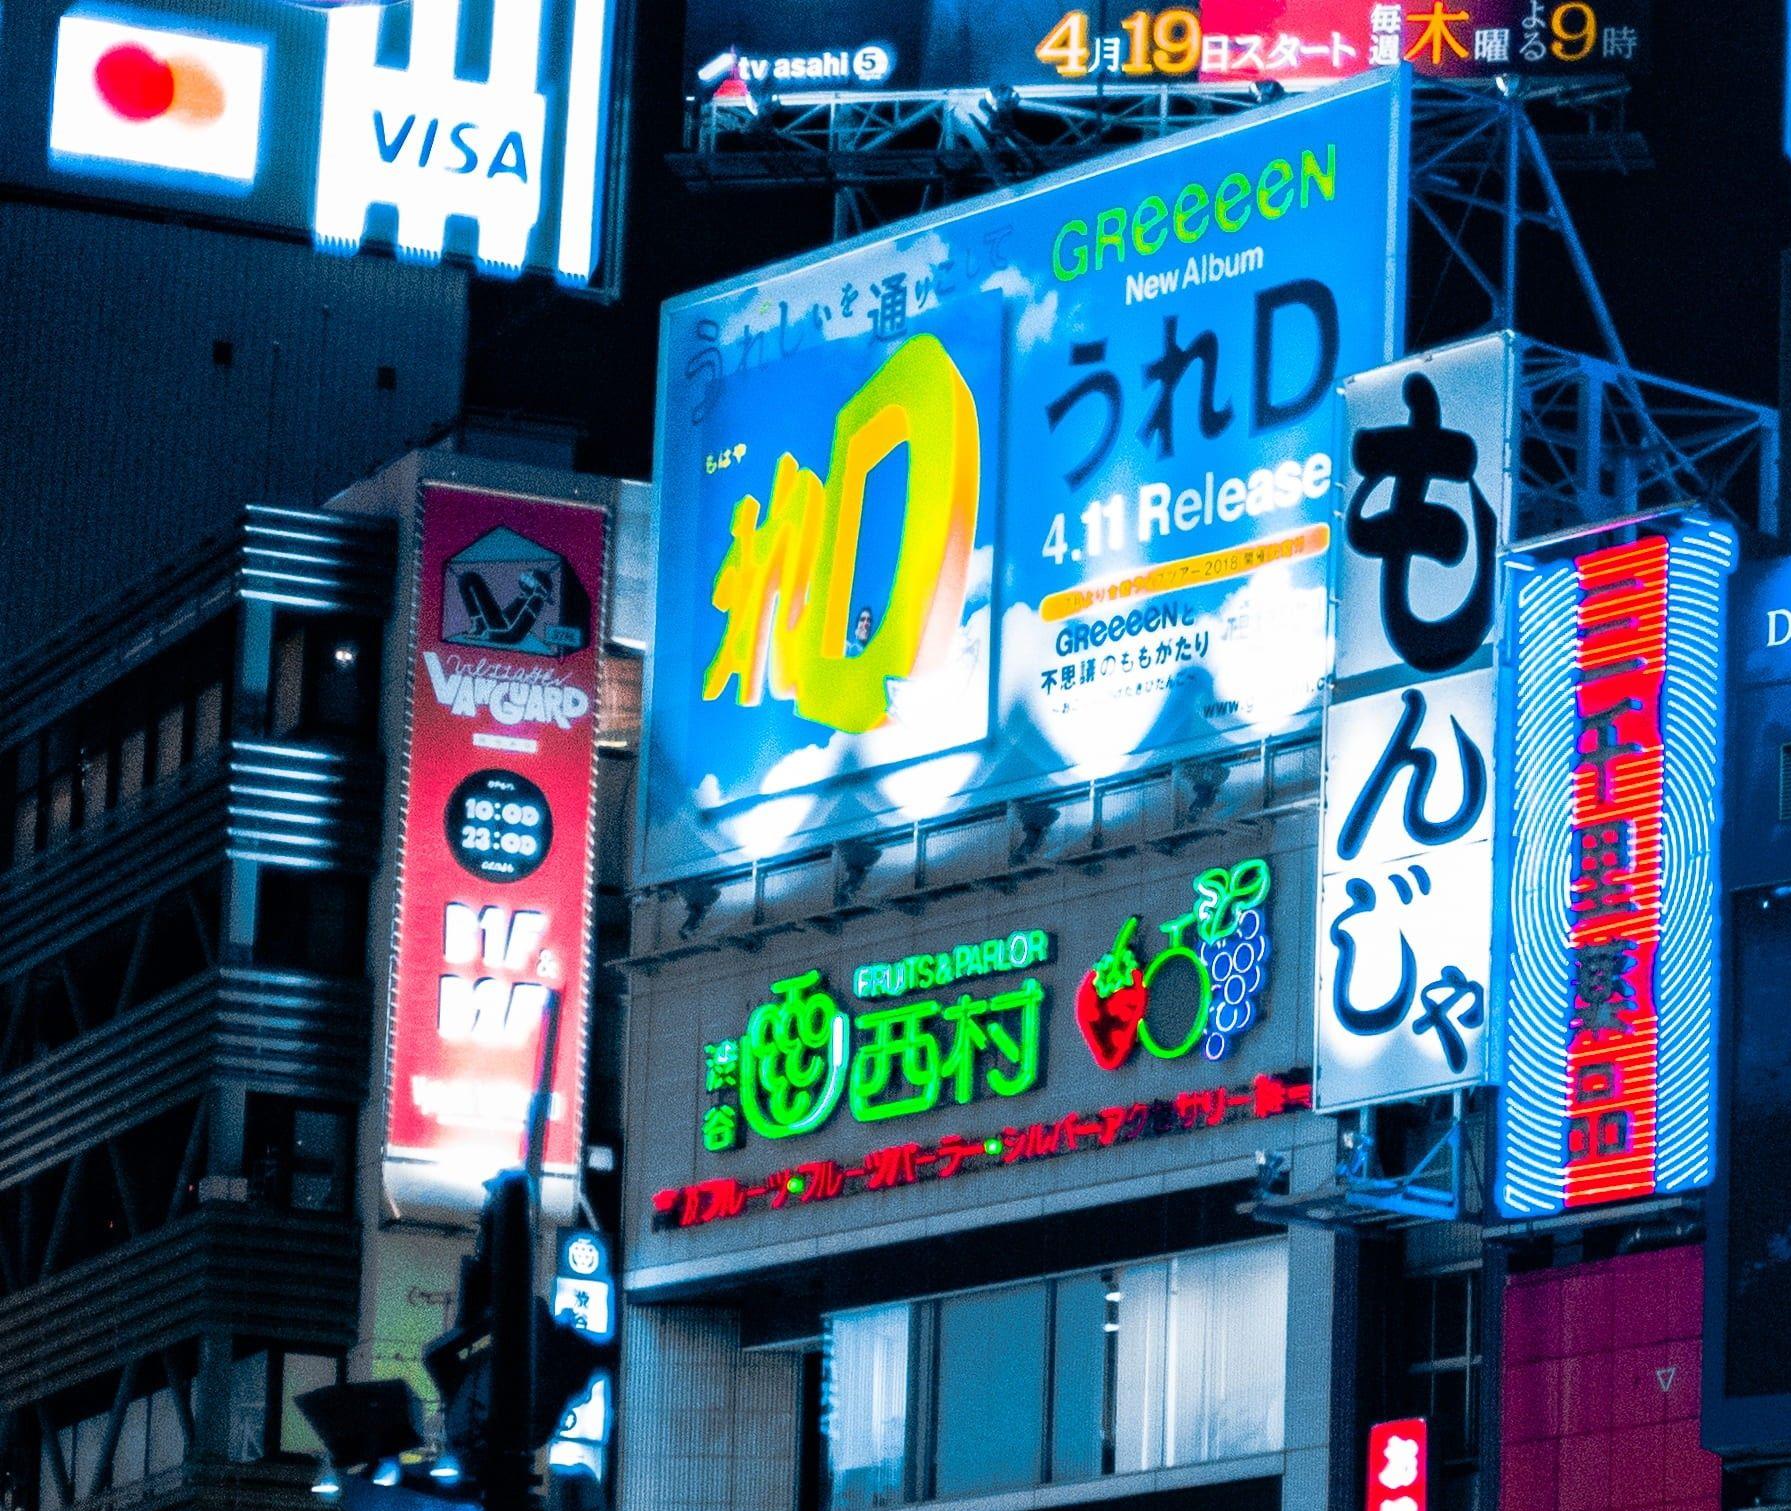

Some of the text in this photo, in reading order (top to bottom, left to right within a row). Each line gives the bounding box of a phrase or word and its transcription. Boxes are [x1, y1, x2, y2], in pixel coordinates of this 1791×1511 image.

[738, 56, 767, 81] tv
[774, 52, 848, 79] asahi
[1035, 10, 1356, 79] 4月19日スタート
[373, 109, 529, 186] VISA
[1126, 244, 1264, 305] New Album
[1042, 452, 1333, 566] 4.11 Release
[1329, 372, 1499, 1075] もんじゃ
[462, 827, 537, 856] 23:00
[465, 799, 539, 827] 10:00
[852, 929, 1048, 998] FRUITS&PARLOR
[850, 978, 1045, 1122] 西村
